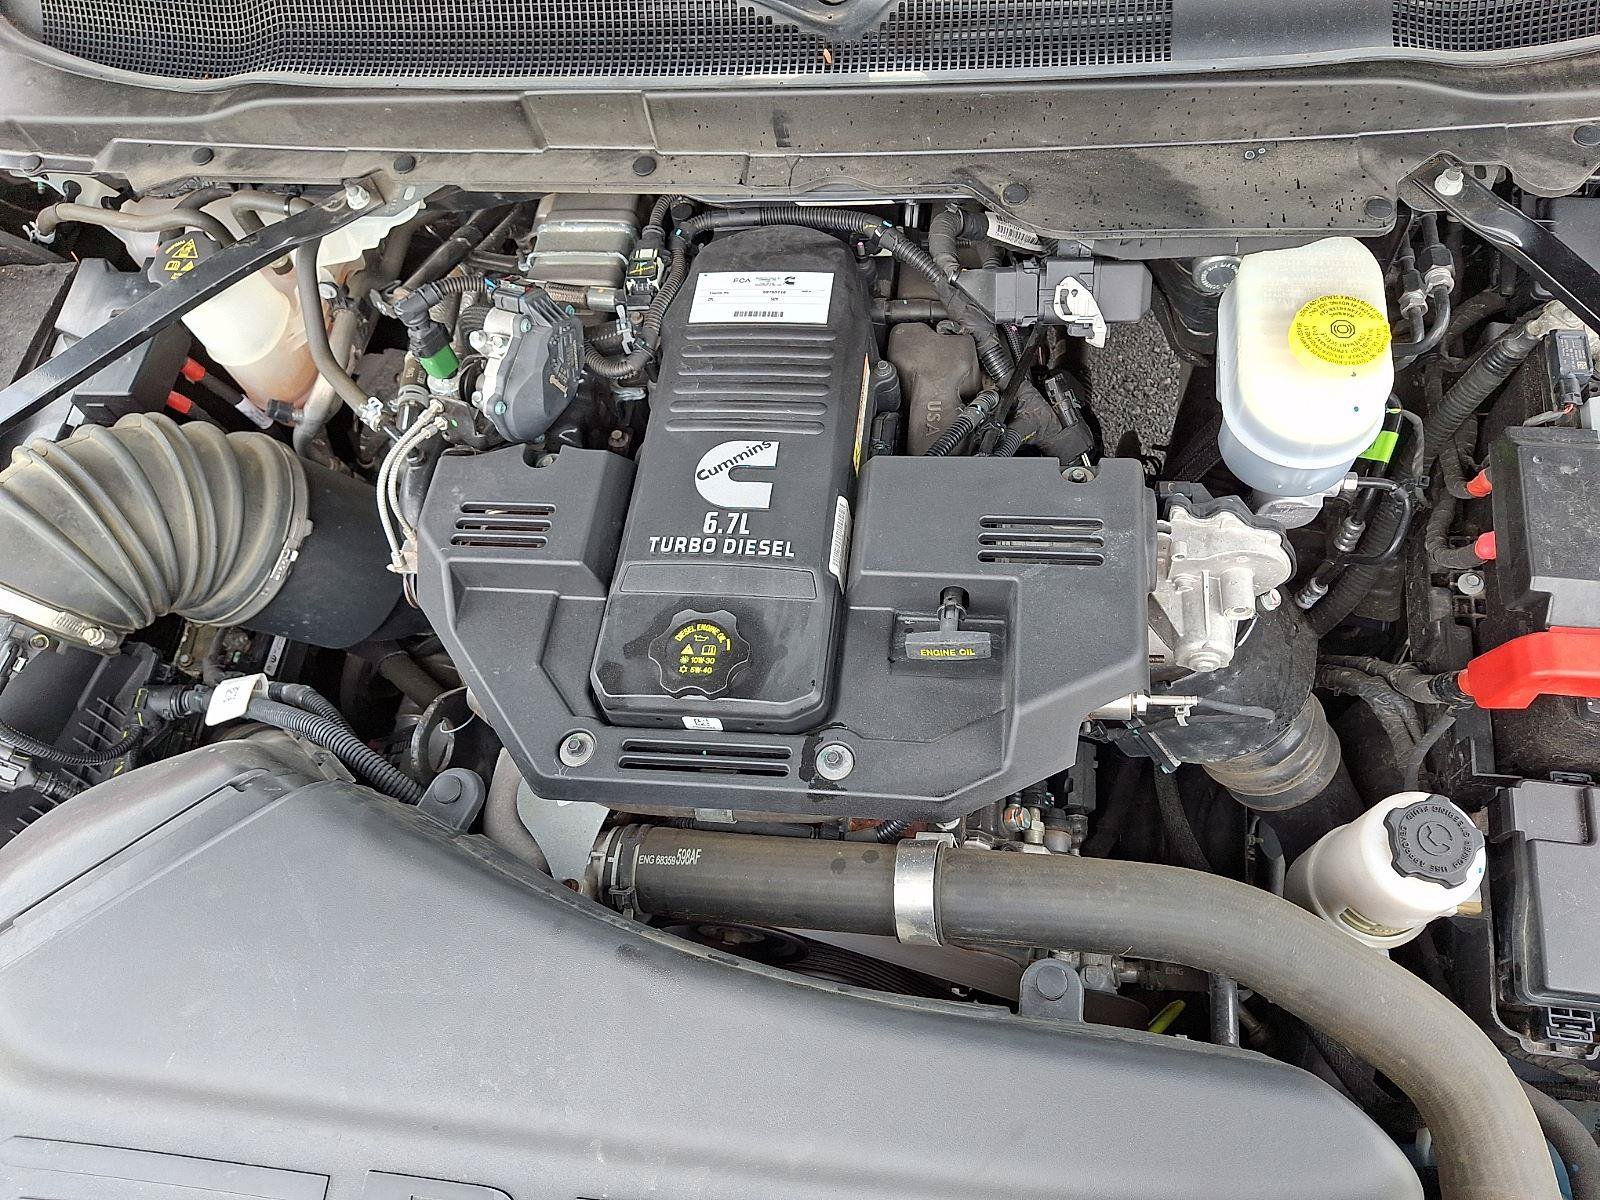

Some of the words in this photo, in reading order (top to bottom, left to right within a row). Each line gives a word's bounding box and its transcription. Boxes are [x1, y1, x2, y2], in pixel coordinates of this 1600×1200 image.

[926, 401, 942, 436] USA
[696, 440, 772, 481] Cummins
[703, 511, 750, 534] 6.7L
[649, 536, 716, 553] TURBO
[722, 538, 795, 558] DIESEL
[674, 625, 696, 642] DIESEL
[920, 648, 956, 656] ENGINE
[958, 648, 976, 656] OIL
[638, 854, 654, 864] ENG
